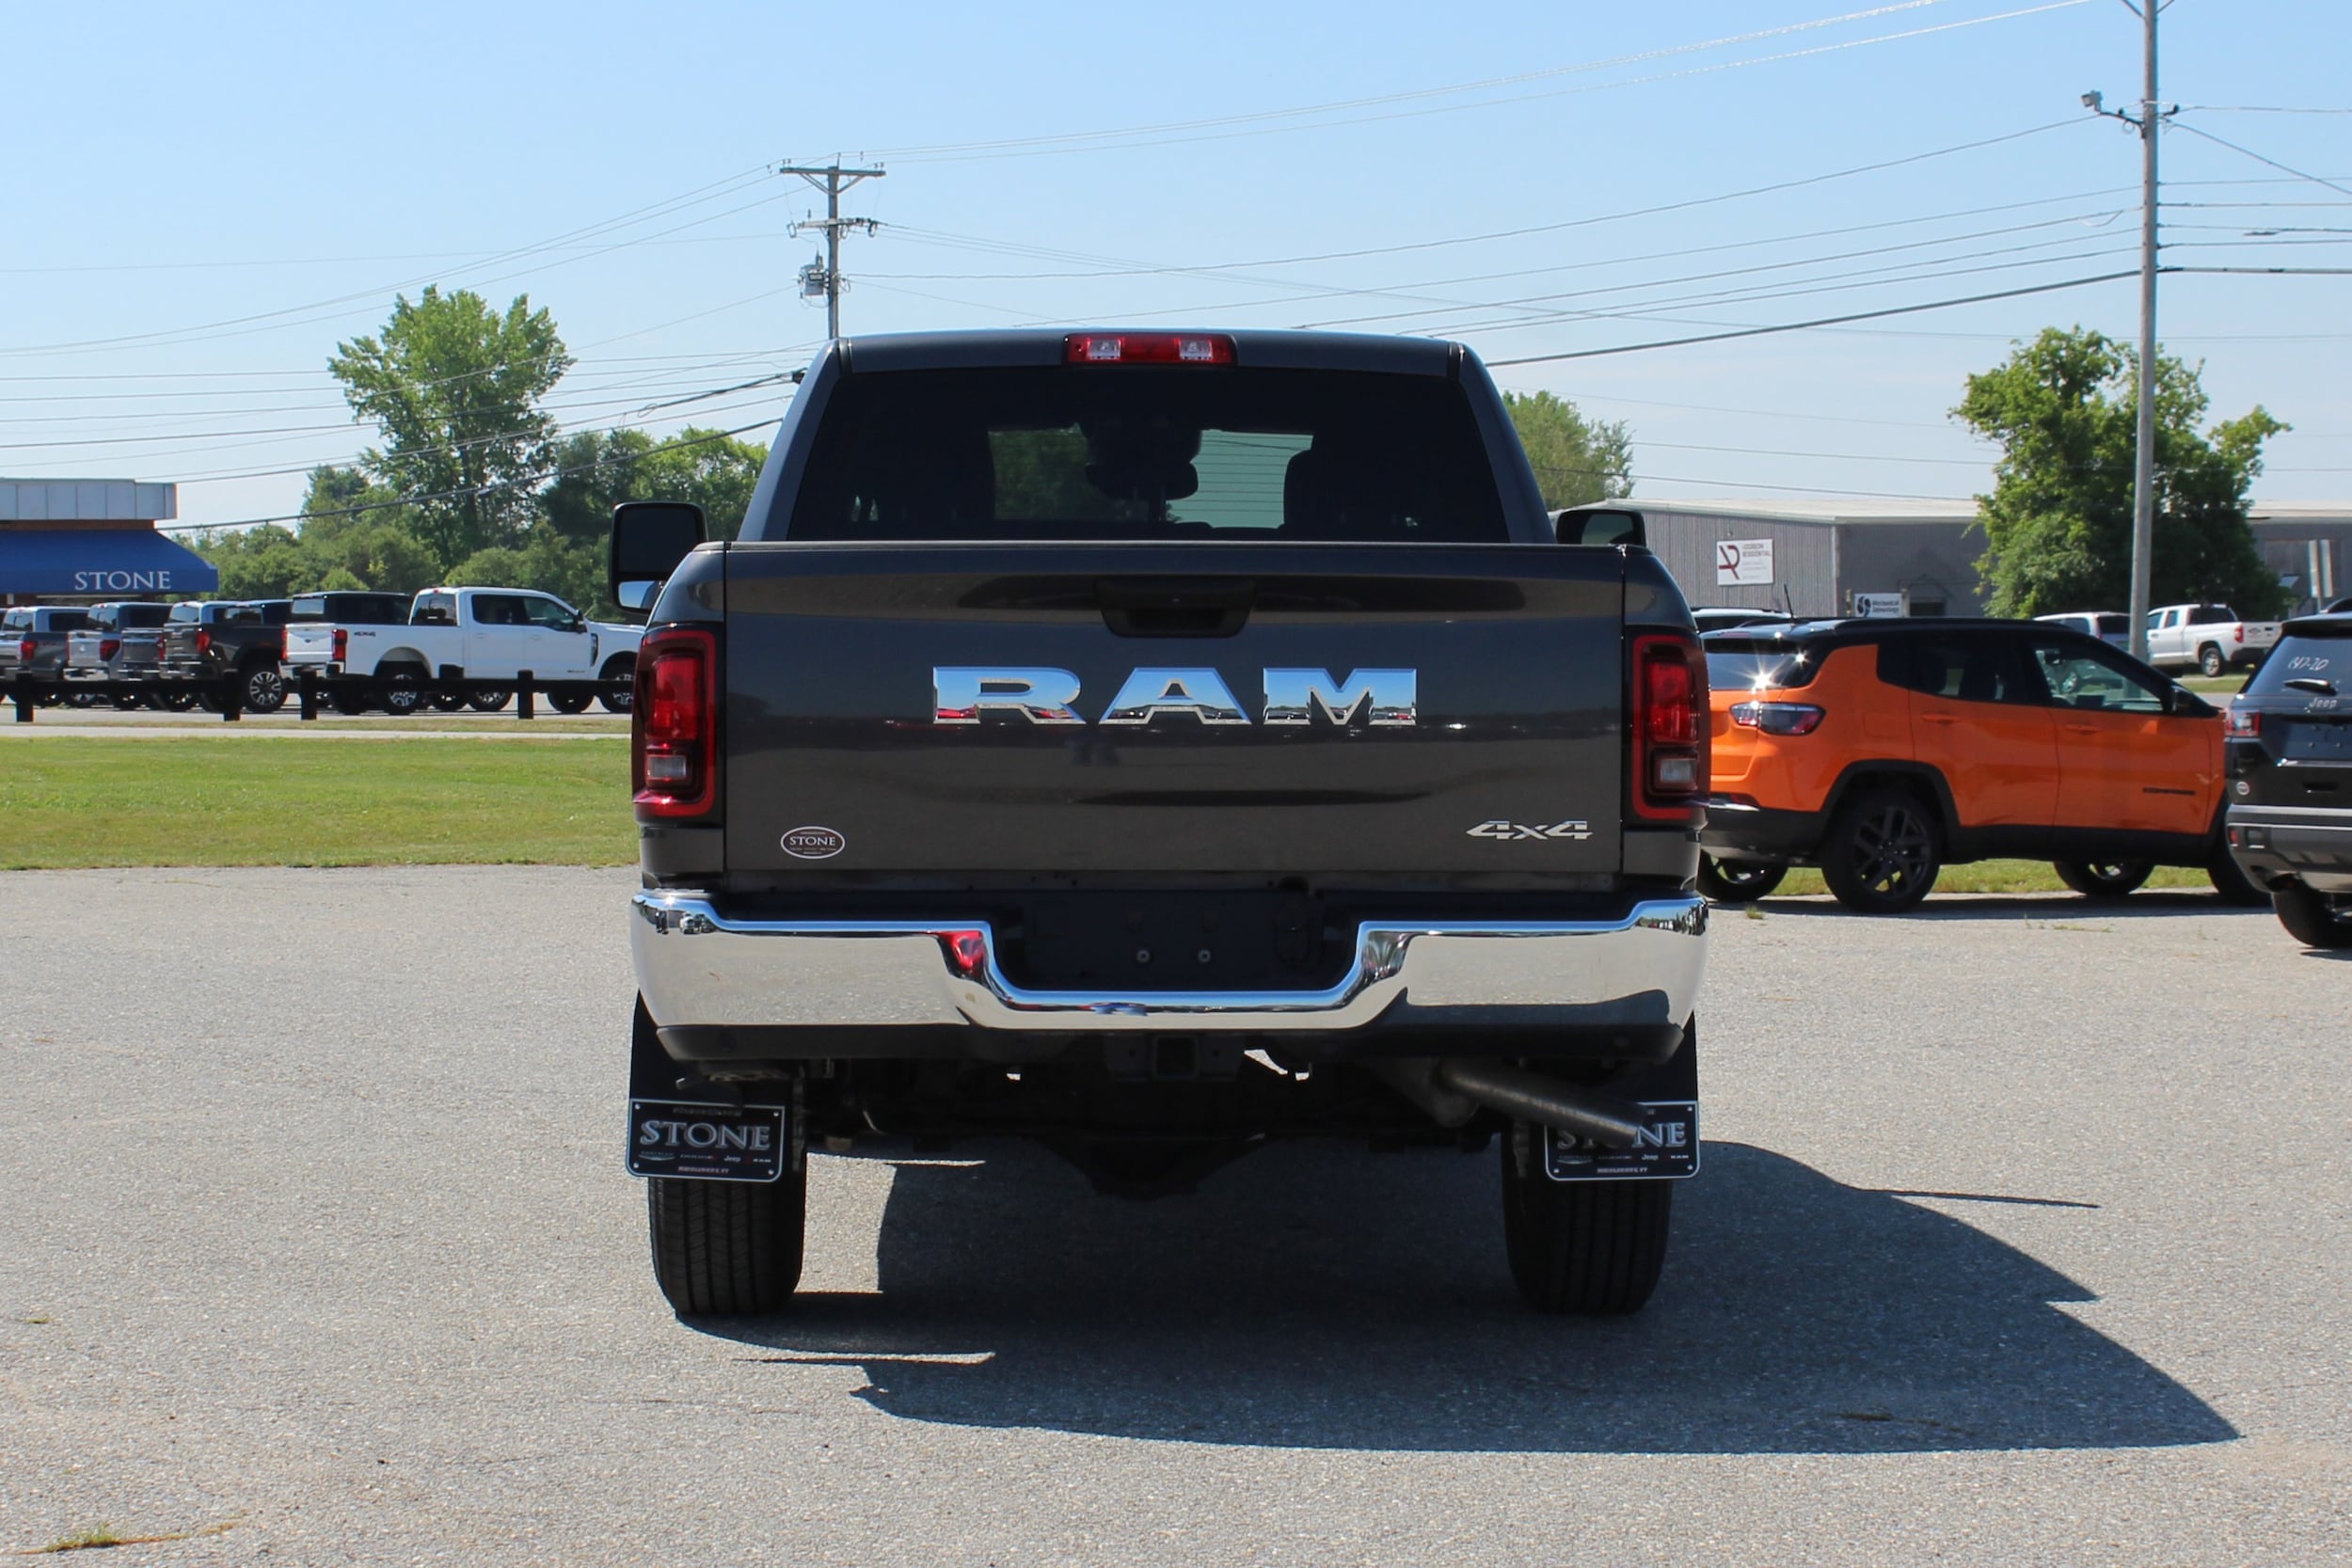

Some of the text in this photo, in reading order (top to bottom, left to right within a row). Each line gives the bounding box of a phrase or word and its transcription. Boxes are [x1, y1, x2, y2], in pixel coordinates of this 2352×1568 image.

[74, 571, 171, 591] STONE
[933, 667, 1417, 725] RAM
[2309, 697, 2338, 709] Jeep
[789, 836, 836, 846] STONE
[640, 1119, 771, 1150] STONE
